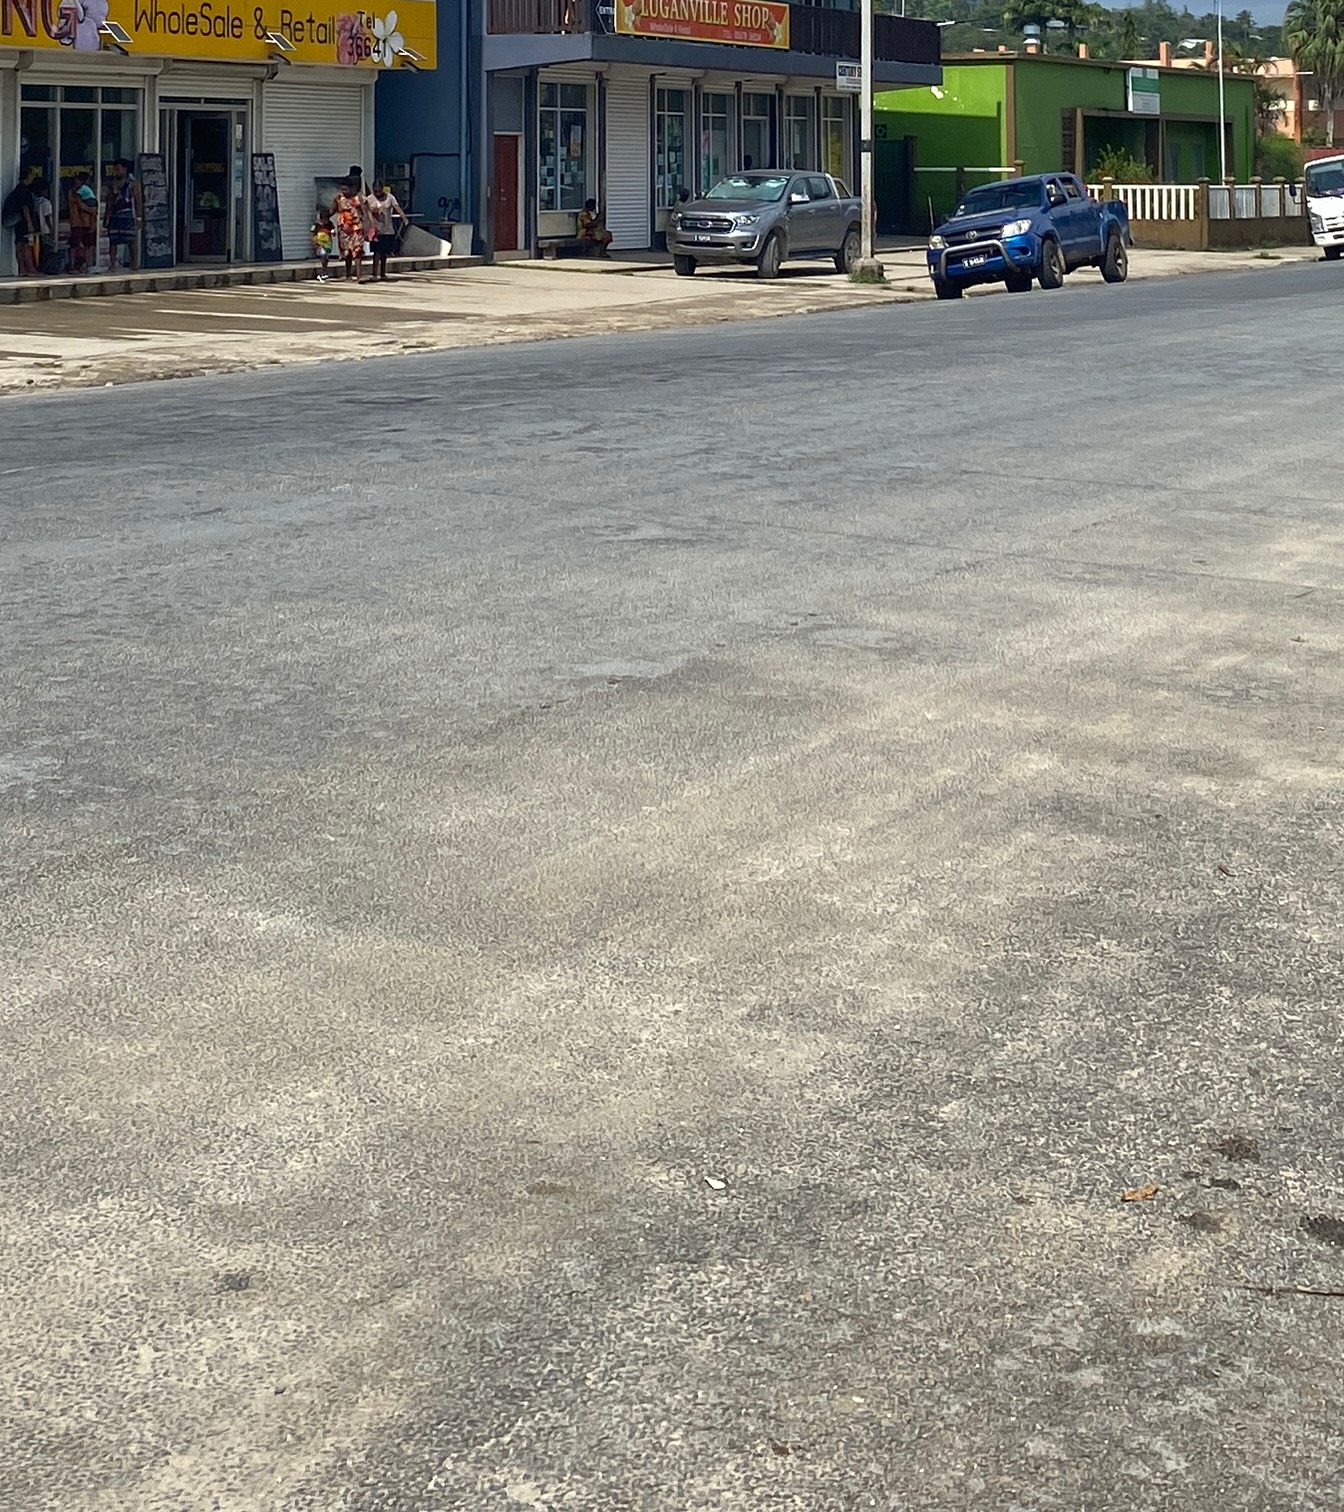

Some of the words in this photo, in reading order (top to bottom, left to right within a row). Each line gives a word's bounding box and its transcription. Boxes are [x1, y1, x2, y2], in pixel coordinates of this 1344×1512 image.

[253, 6, 269, 40] &
[280, 9, 336, 45] Retail
[356, 10, 376, 29] Tel
[734, 2, 769, 30] SHOP
[346, 36, 388, 58] 36641
